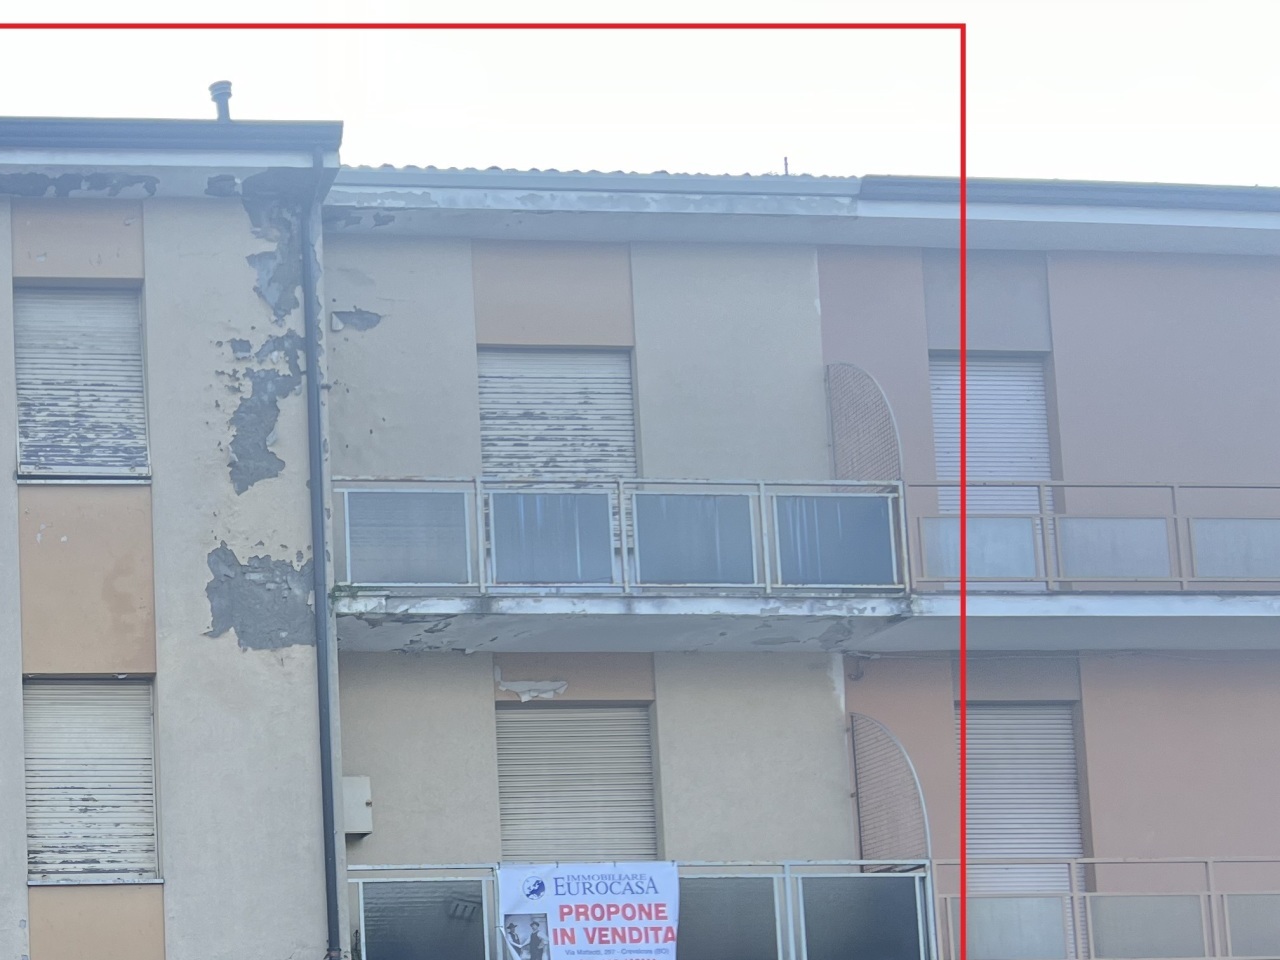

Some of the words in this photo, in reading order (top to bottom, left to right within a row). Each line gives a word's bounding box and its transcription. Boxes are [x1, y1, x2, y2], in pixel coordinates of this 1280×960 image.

[553, 876, 659, 896] EUROCASA
[559, 903, 668, 921] PROPONE
[552, 928, 576, 945] IN
[583, 926, 676, 944] VENDITA
